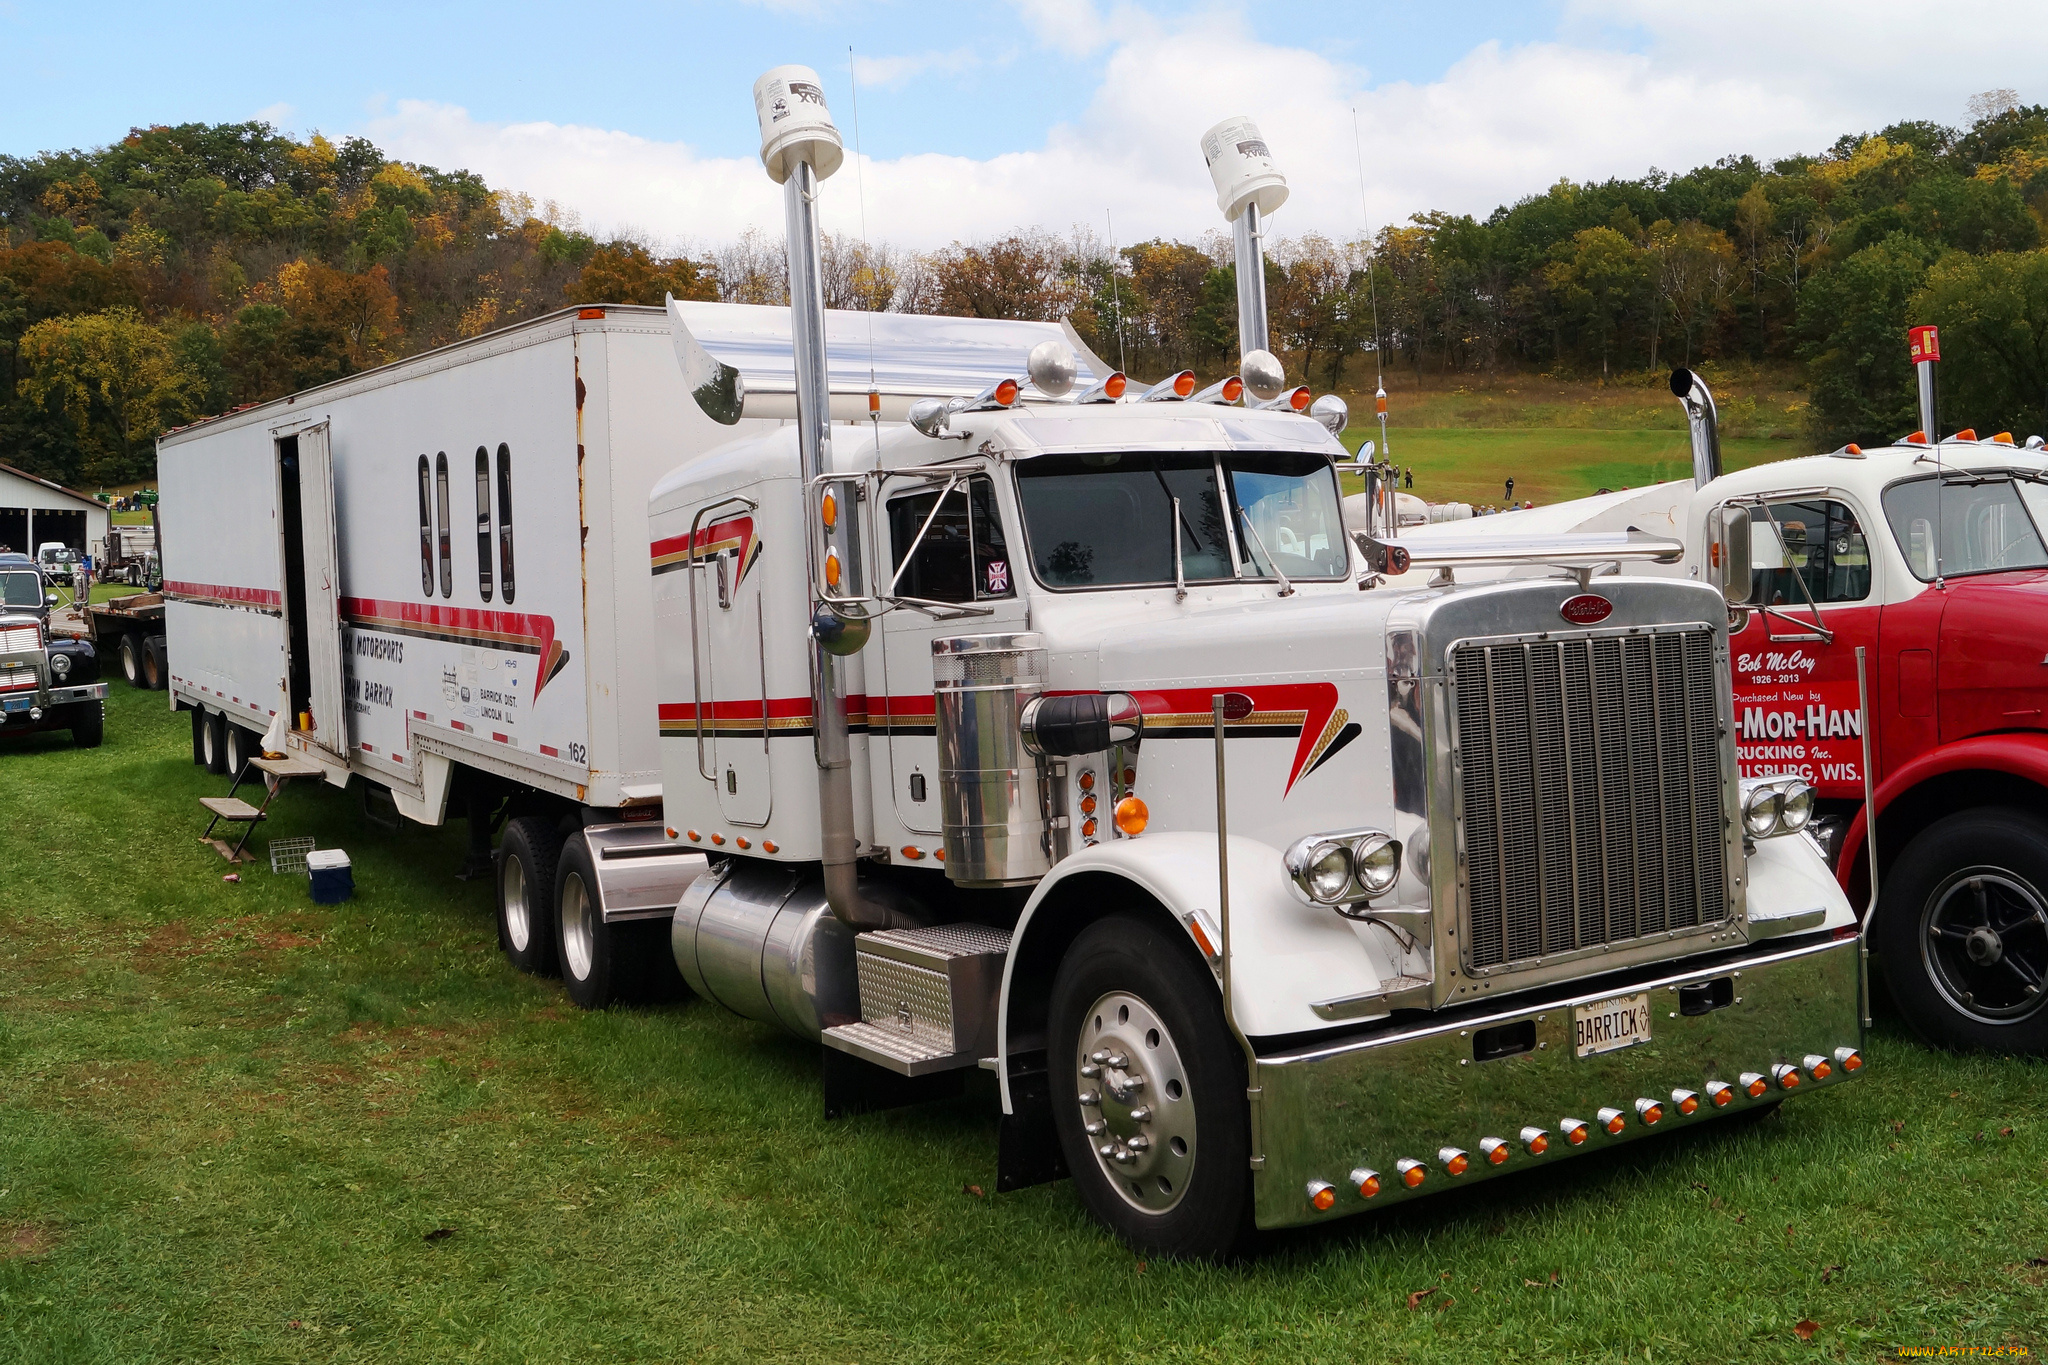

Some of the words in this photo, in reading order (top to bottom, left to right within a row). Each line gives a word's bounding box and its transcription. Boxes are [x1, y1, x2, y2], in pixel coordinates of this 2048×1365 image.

[357, 635, 404, 664] MOTORSPORTS
[1738, 653, 1763, 673] Bob
[1766, 650, 1816, 674] McCoy
[1752, 675, 1772, 684] 1926
[1779, 674, 1799, 683] 2013
[364, 680, 393, 708] BARRICK
[480, 688, 502, 704] BARRICK
[1732, 691, 1778, 703] Purchased
[1783, 691, 1804, 701] New
[1810, 690, 1821, 702] by
[481, 705, 502, 721] LINCOLN
[568, 741, 587, 764] 162
[1811, 746, 1832, 759] Inc.
[1821, 763, 1862, 781] WIS.
[1593, 996, 1628, 1011] ILLINOIS
[1576, 1008, 1638, 1047] BARRICK
